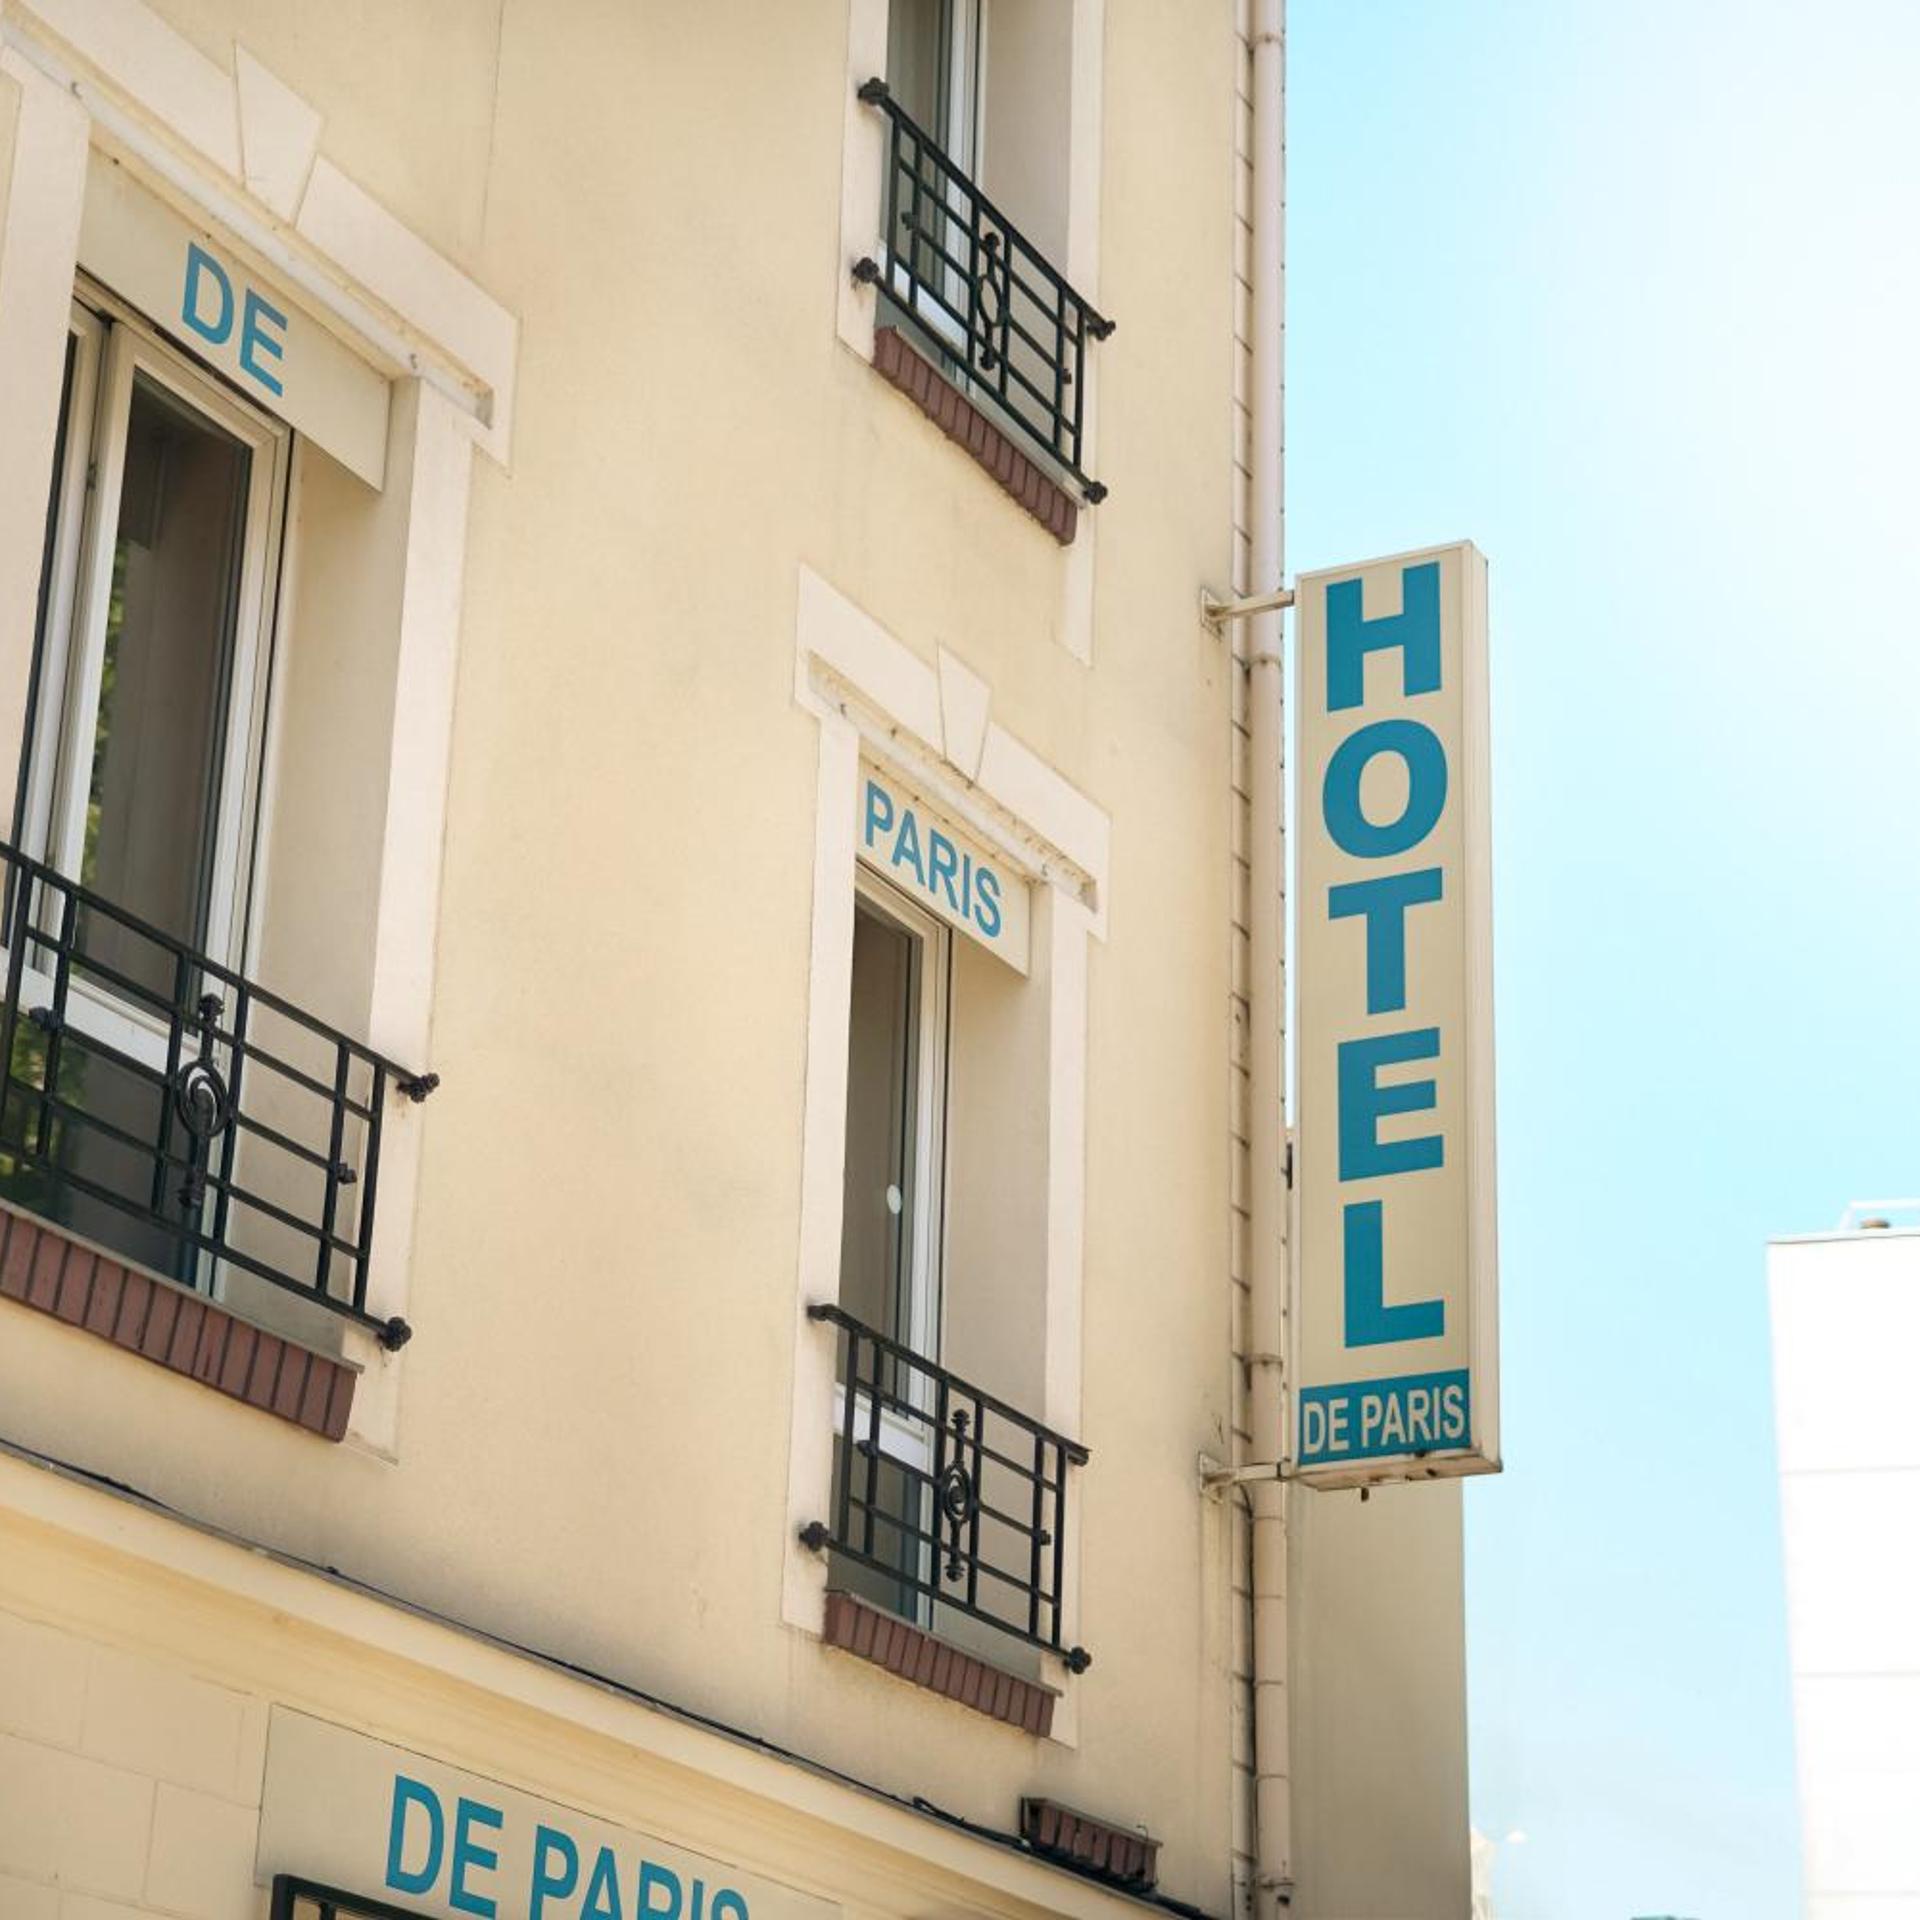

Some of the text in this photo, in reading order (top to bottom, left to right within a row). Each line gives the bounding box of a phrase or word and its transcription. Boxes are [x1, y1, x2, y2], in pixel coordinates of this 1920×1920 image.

[182, 241, 288, 398] DE
[864, 779, 1001, 938] PARIS
[1322, 561, 1448, 1348] HOTEL
[1303, 1384, 1465, 1454] DE PARIS
[386, 1774, 750, 1920] DE PAR
